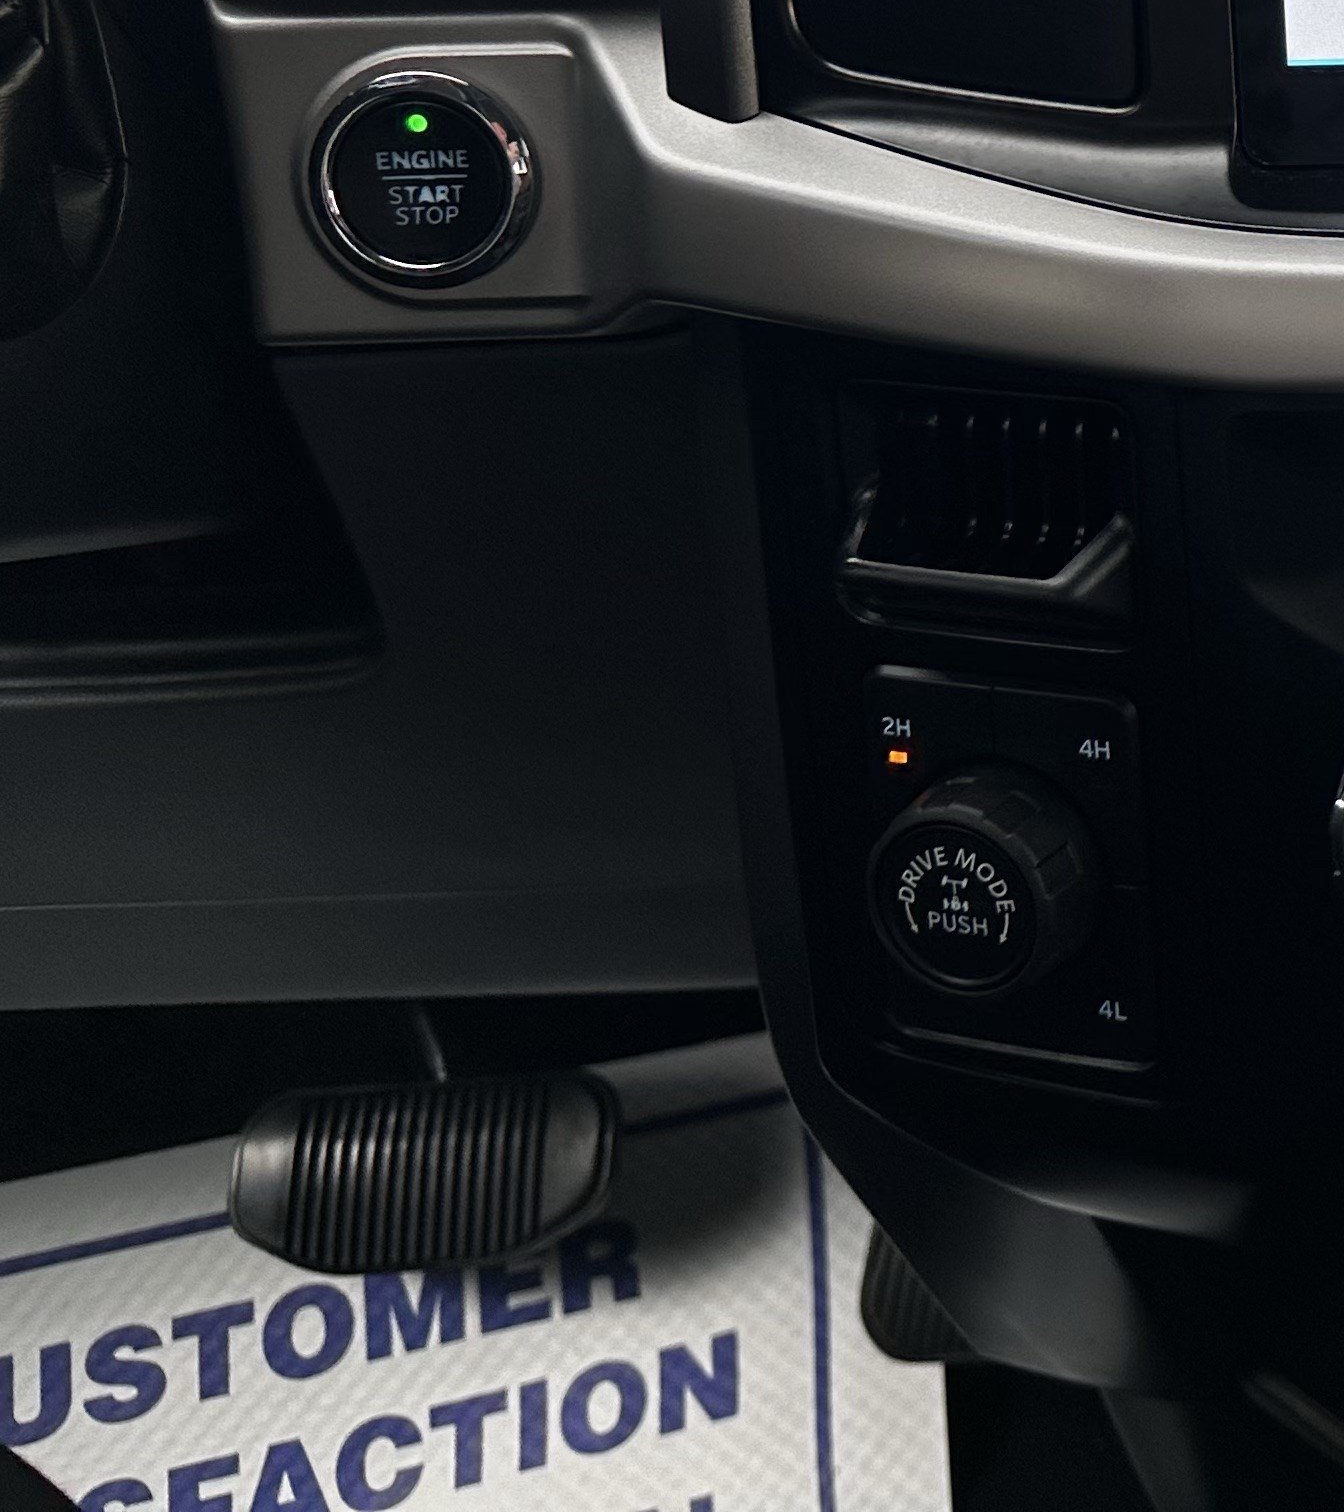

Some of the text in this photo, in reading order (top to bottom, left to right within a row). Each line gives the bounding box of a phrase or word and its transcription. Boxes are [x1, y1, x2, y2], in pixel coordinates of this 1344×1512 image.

[375, 149, 470, 170] ENGINE
[388, 185, 464, 205] START
[395, 206, 460, 226] STOP
[881, 716, 911, 738] 2H
[1078, 739, 1111, 760] 4H
[898, 846, 1016, 913] DRIVE MODE
[928, 911, 988, 936] PUSH
[1098, 1000, 1127, 1021] 4L
